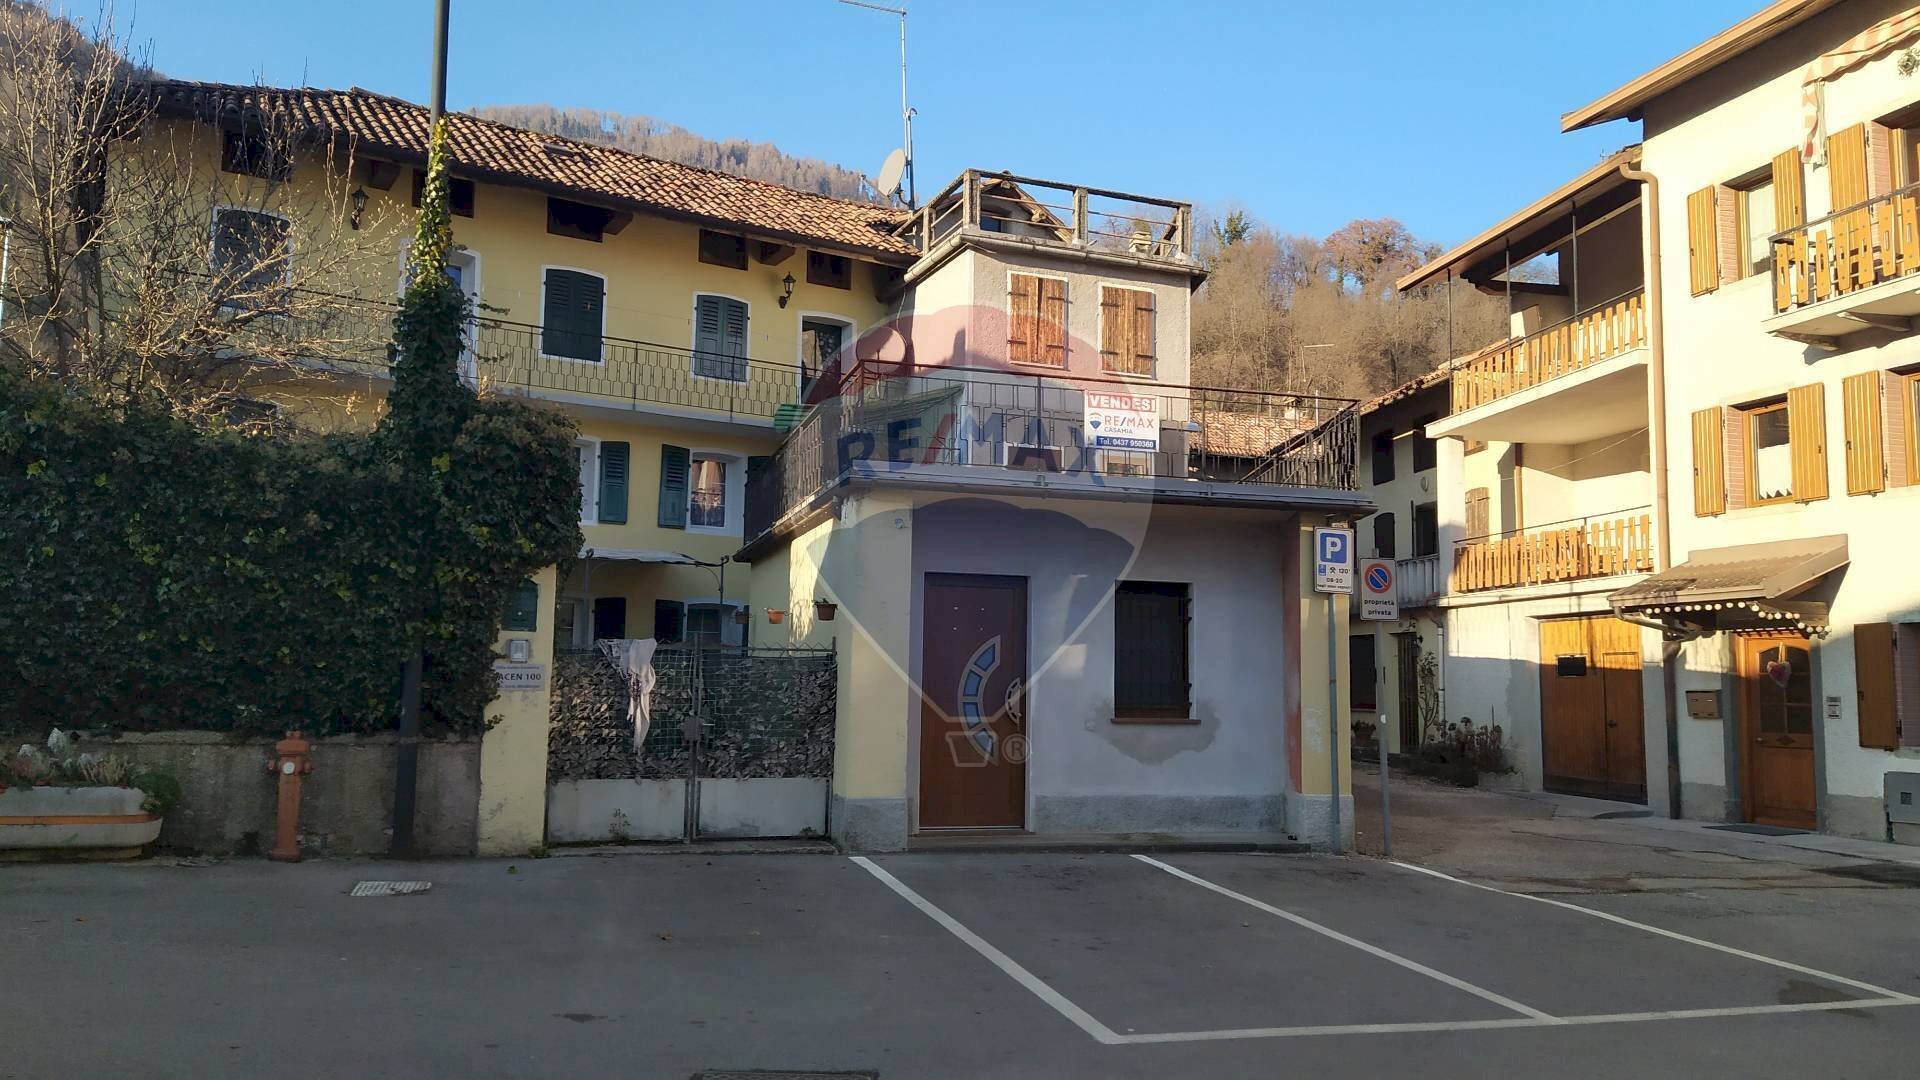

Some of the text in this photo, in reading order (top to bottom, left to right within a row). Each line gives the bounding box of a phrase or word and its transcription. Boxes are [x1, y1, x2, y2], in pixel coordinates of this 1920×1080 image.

[1089, 395, 1155, 411] VENDESI
[1104, 415, 1154, 428] RE/MAX
[1104, 426, 1133, 434] CASAMIA
[1099, 437, 1111, 445] Tel.
[1325, 536, 1342, 559] P
[526, 673, 542, 681] 100
